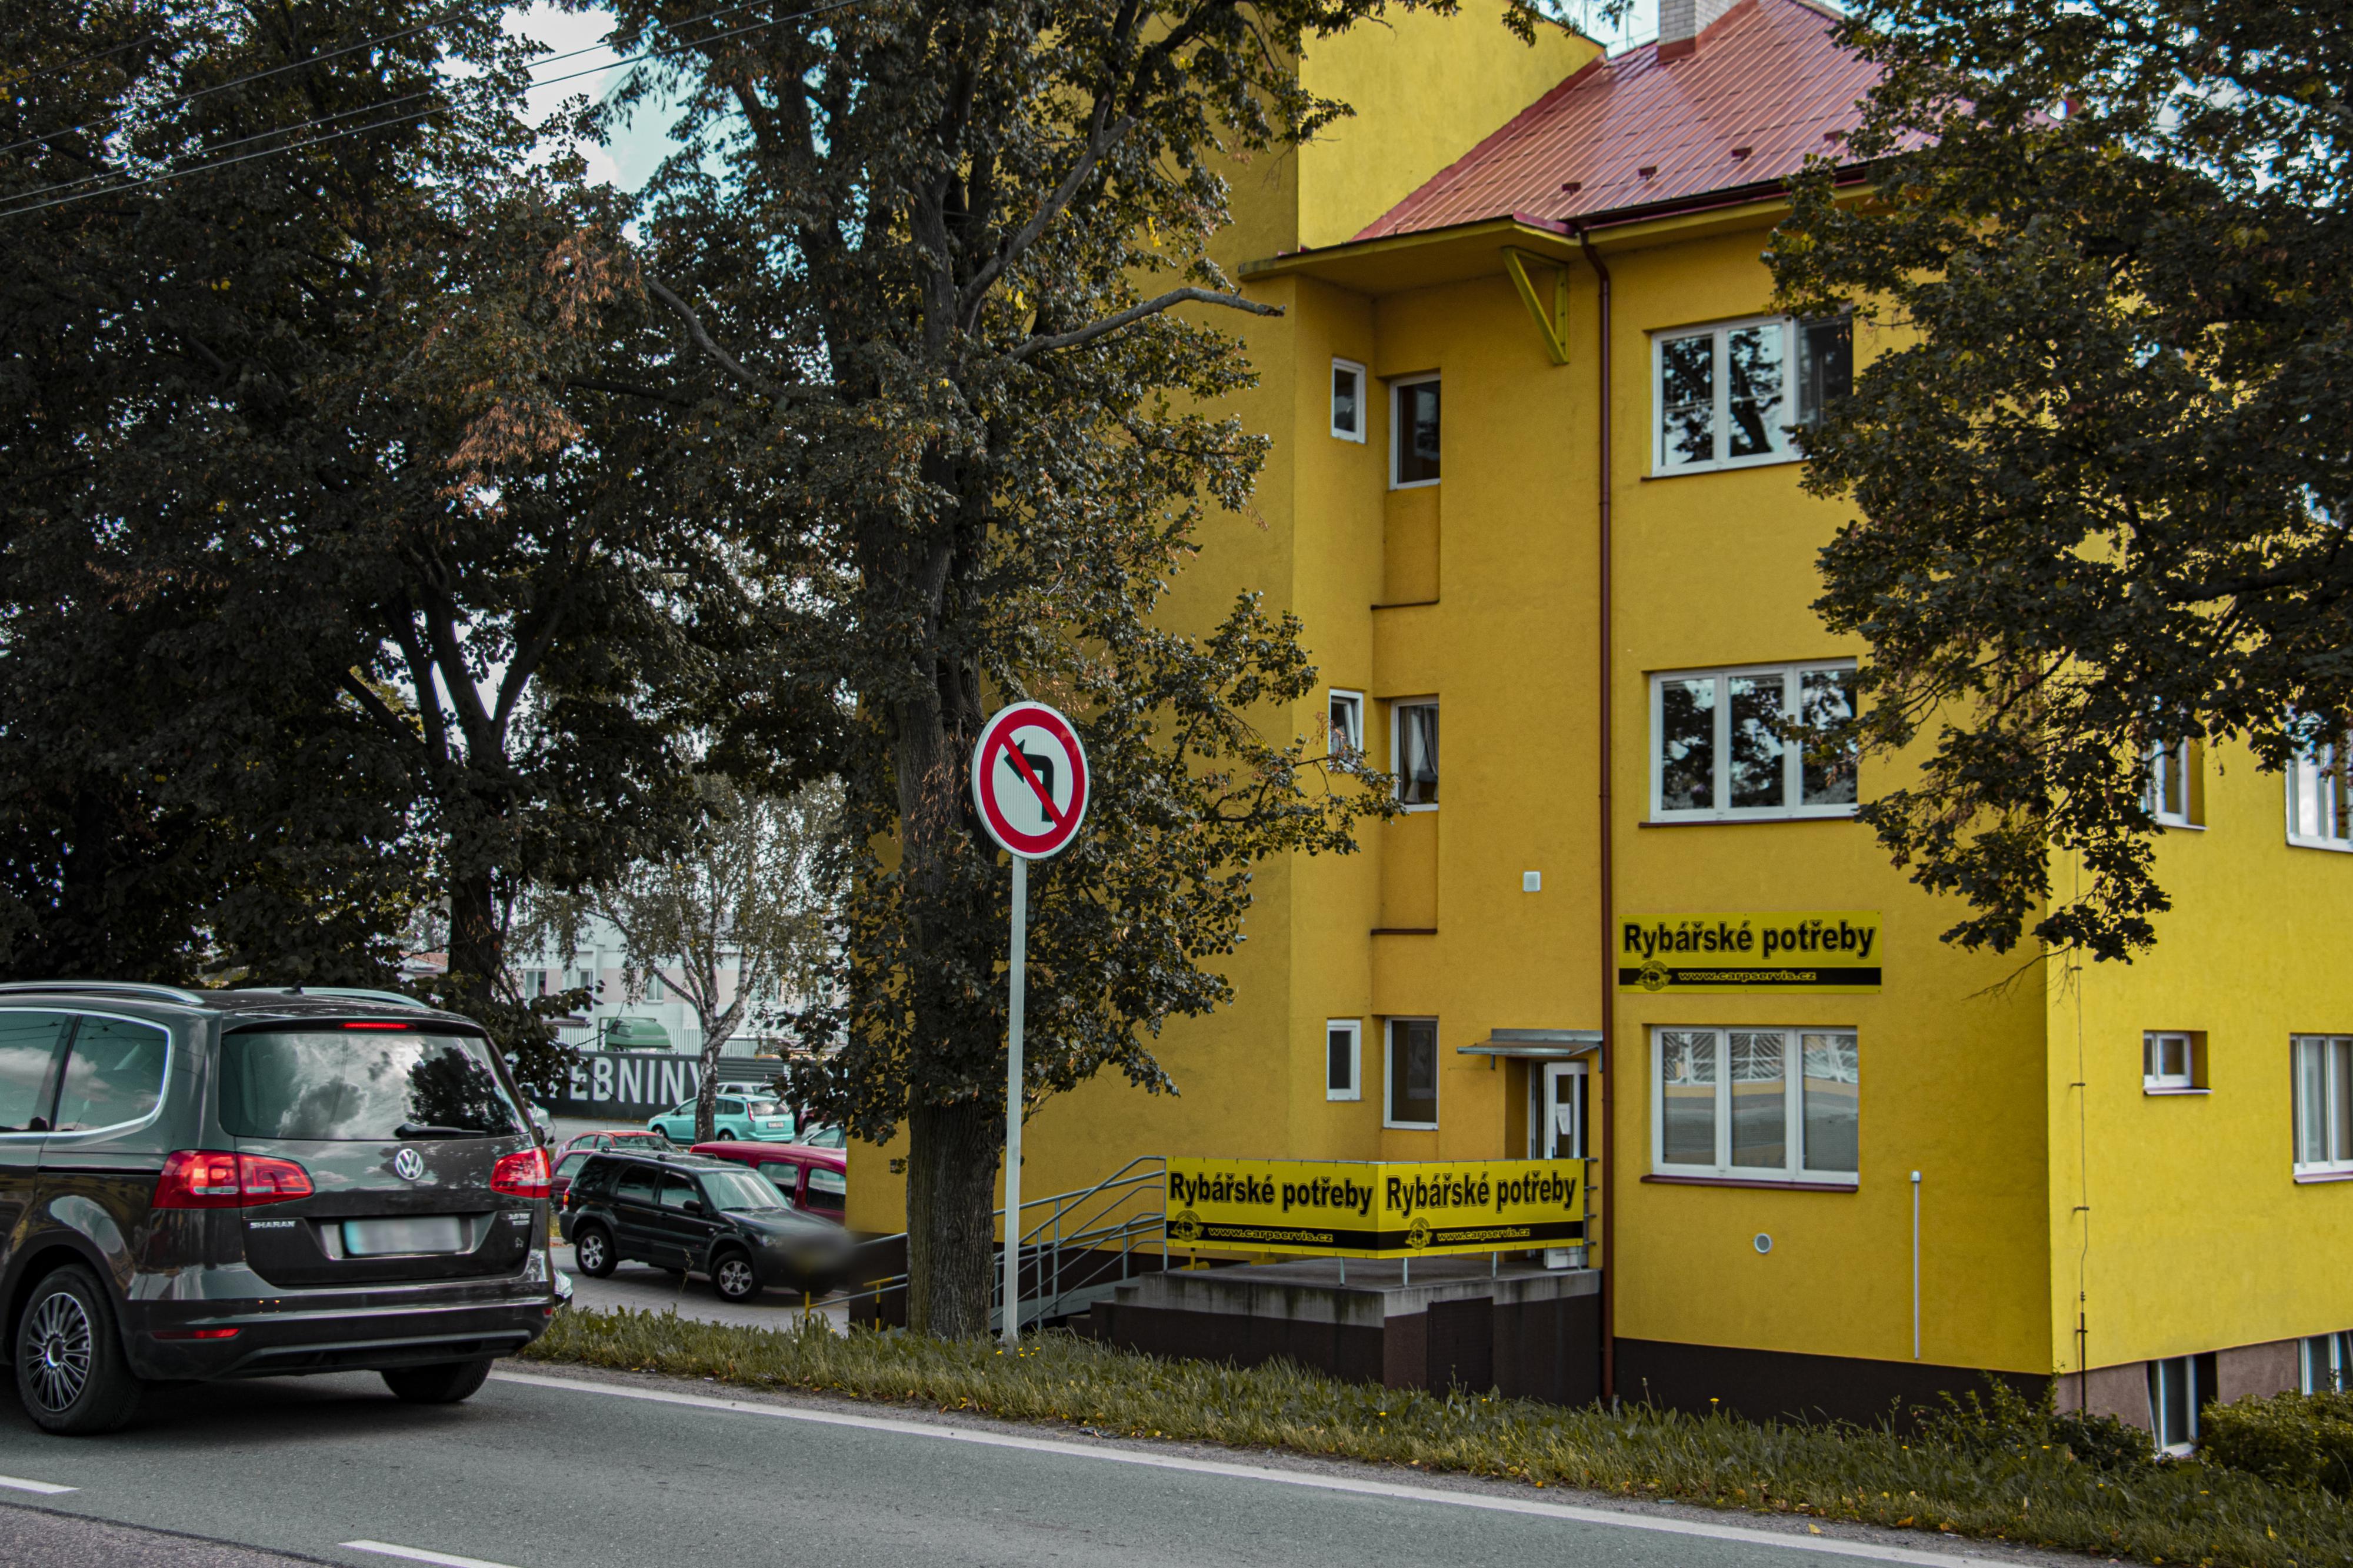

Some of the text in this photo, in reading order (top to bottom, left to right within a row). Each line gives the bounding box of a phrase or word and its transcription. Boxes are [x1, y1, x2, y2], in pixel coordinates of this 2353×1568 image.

[1624, 919, 1876, 959] Rybářské potřeby
[1678, 970, 1817, 982] www.carpservis.cz
[1169, 1171, 1374, 1216] Rybářské potřeby
[1386, 1170, 1578, 1218] Rybářské potřeby
[1208, 1227, 1333, 1242] www.carpservis.cz
[1437, 1227, 1530, 1241] www.carpservis.cz
